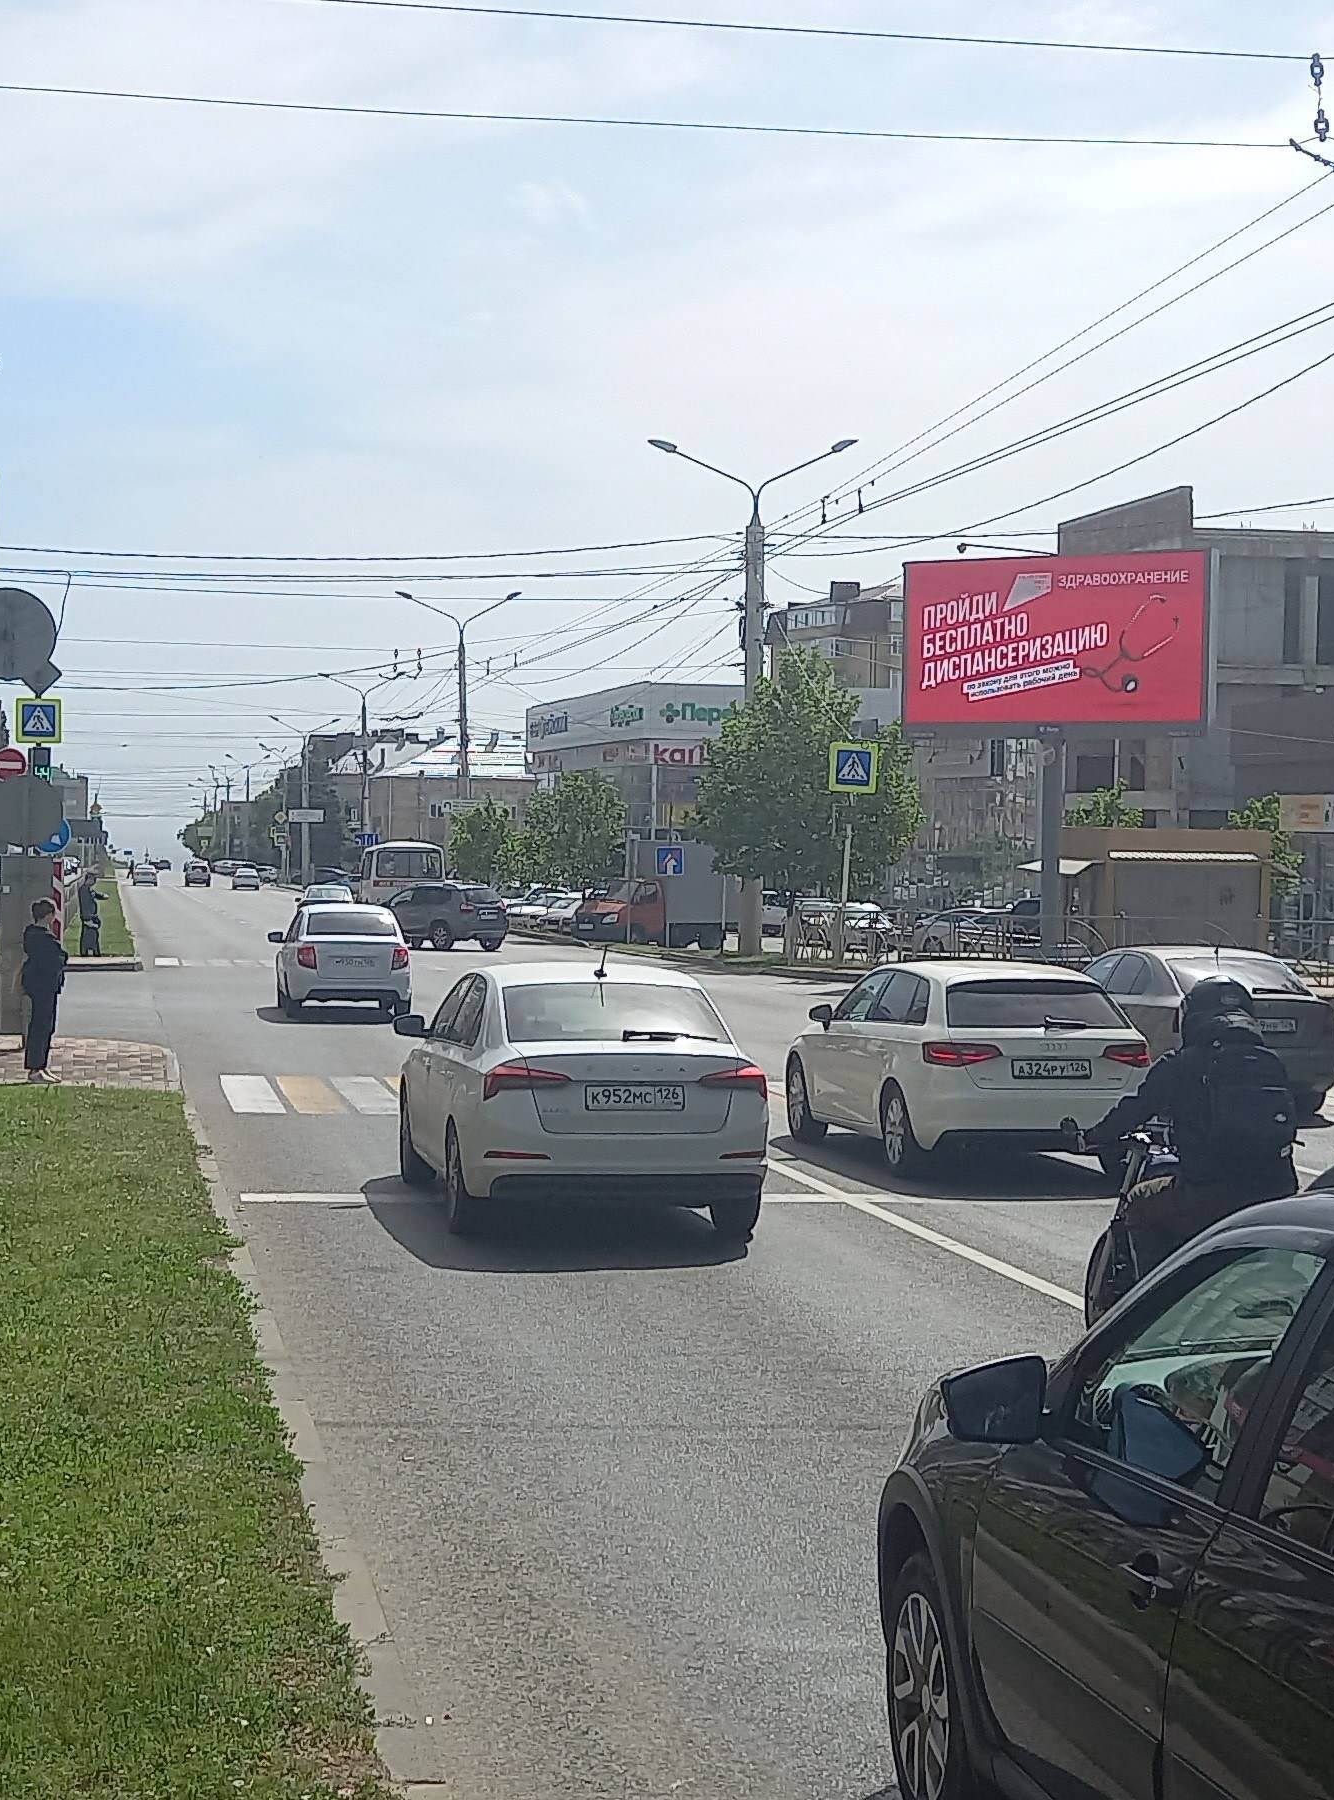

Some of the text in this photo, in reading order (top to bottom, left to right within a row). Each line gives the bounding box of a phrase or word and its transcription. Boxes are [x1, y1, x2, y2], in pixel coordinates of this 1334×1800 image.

[1058, 570, 1189, 589] ЗДРАВООХРАНЕНИЕ
[922, 591, 998, 631] ПРОЙДИ
[922, 612, 1028, 659] БЕСПЛАТНО
[921, 622, 1108, 690] ДИСПАНСЕРИЗАЦИЮ
[1018, 1062, 1088, 1077] А324РУ 126
[591, 1087, 680, 1105] К952МС 126
